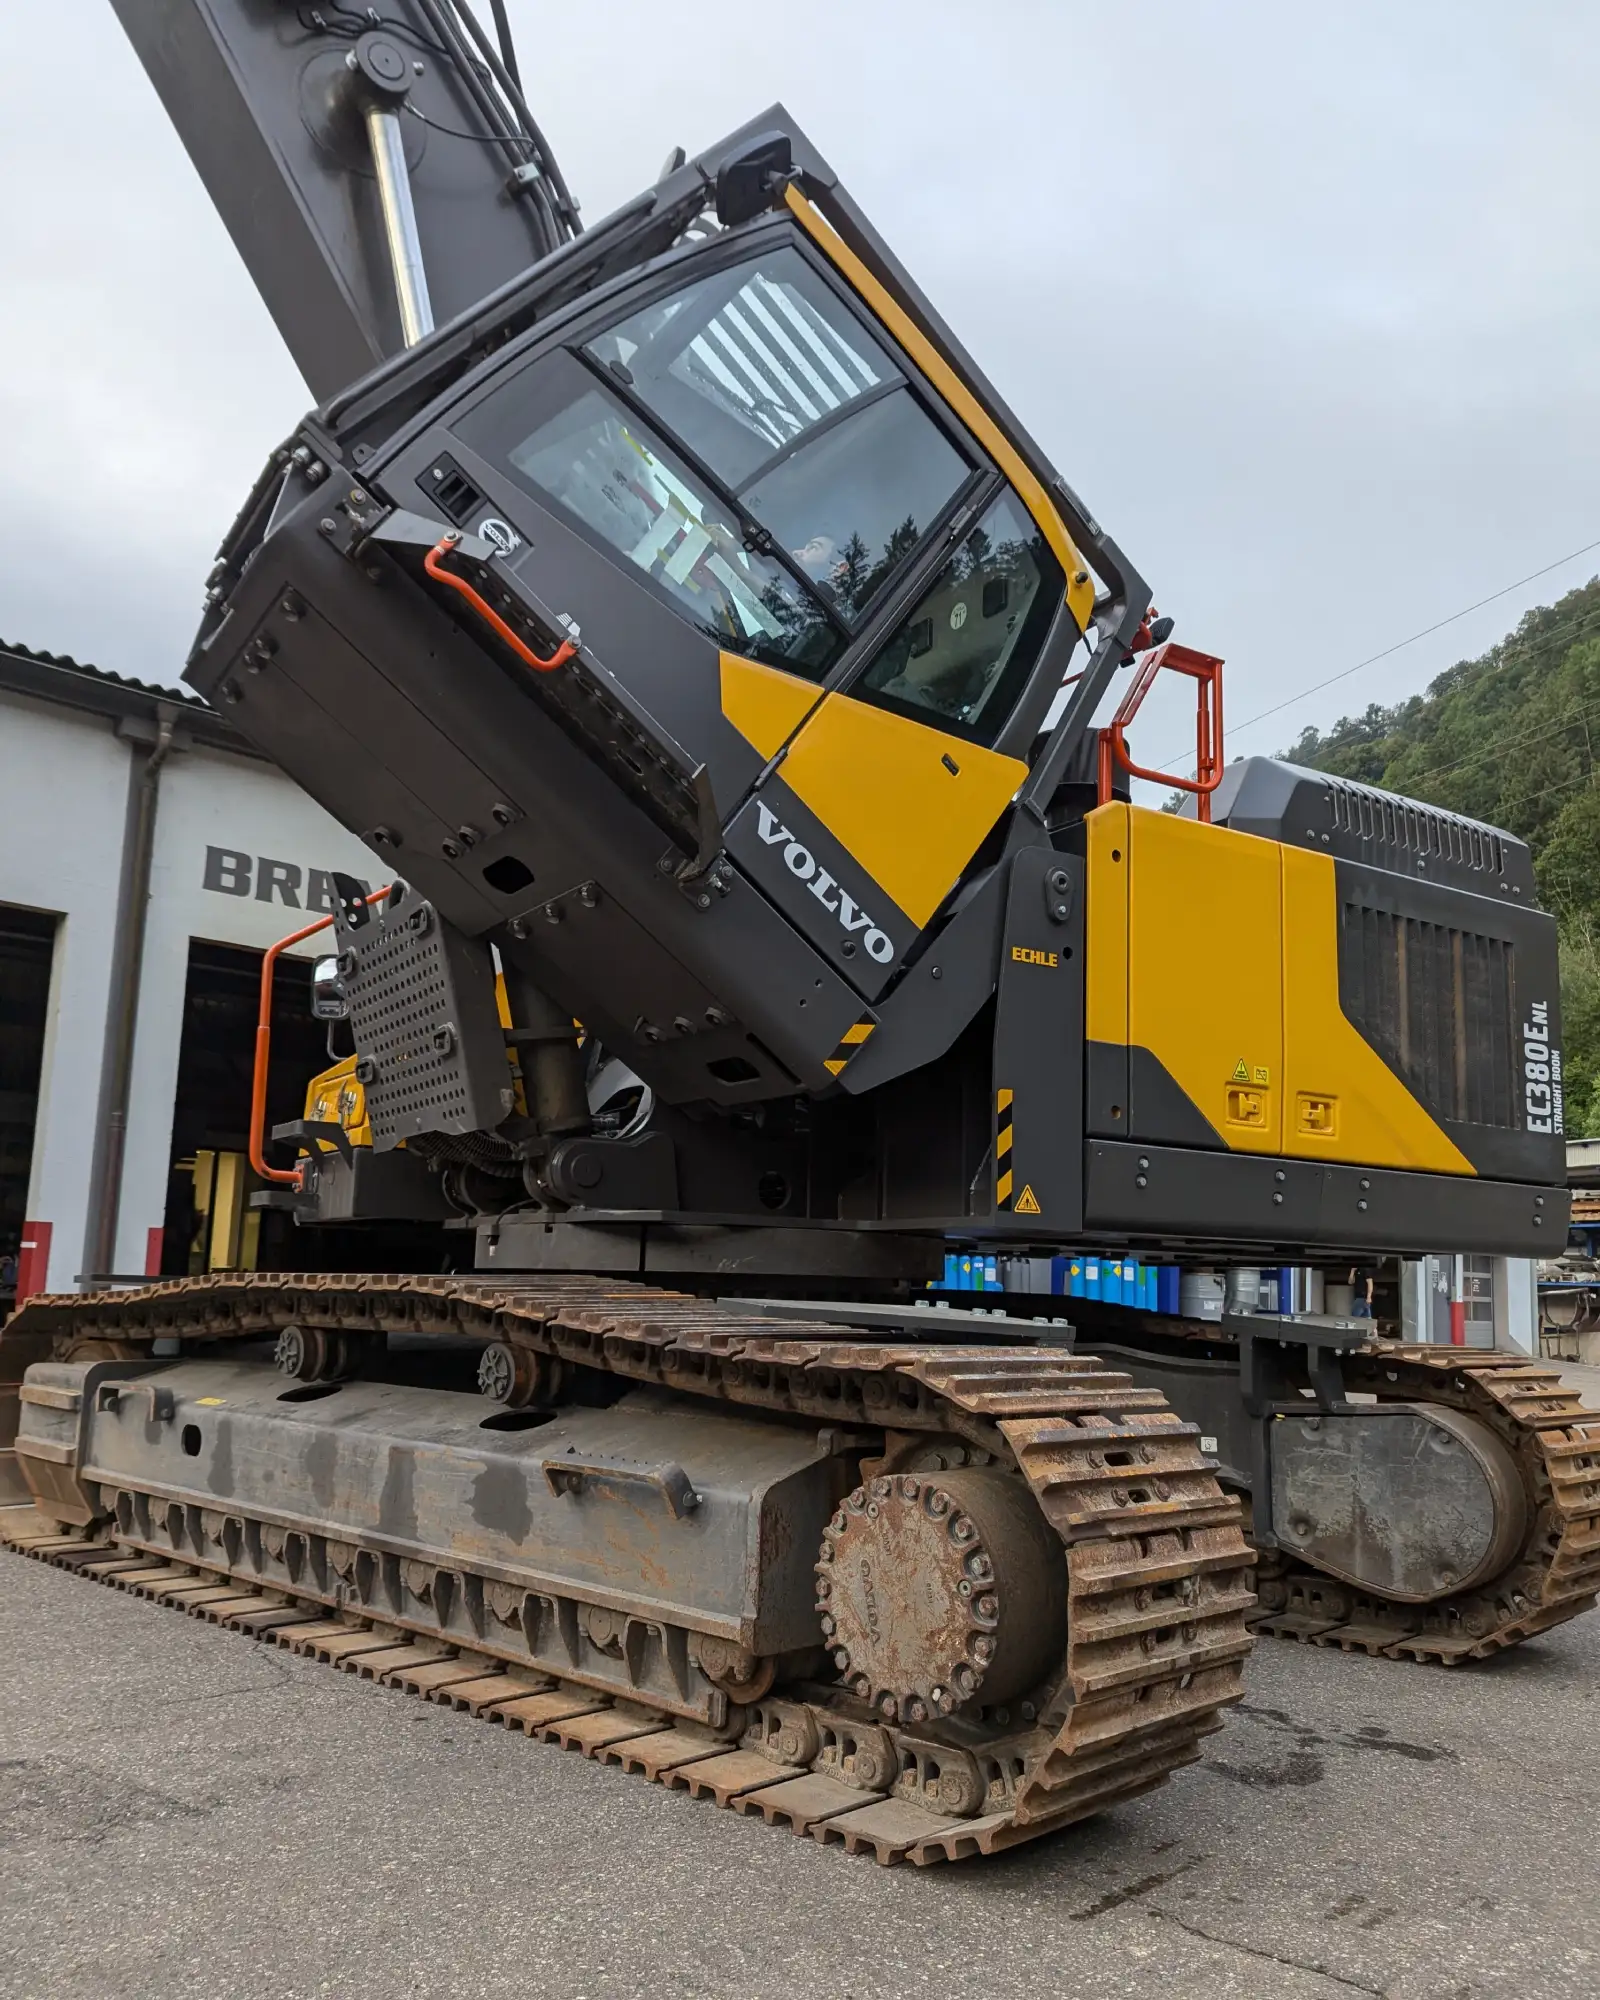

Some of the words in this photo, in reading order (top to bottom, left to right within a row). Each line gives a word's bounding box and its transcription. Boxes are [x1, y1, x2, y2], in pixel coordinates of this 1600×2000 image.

[756, 800, 895, 964] VOLVO
[1012, 946, 1058, 968] ECHLE
[1551, 1050, 1561, 1081] BOOM
[1551, 1082, 1563, 1135] STRAIGHT
